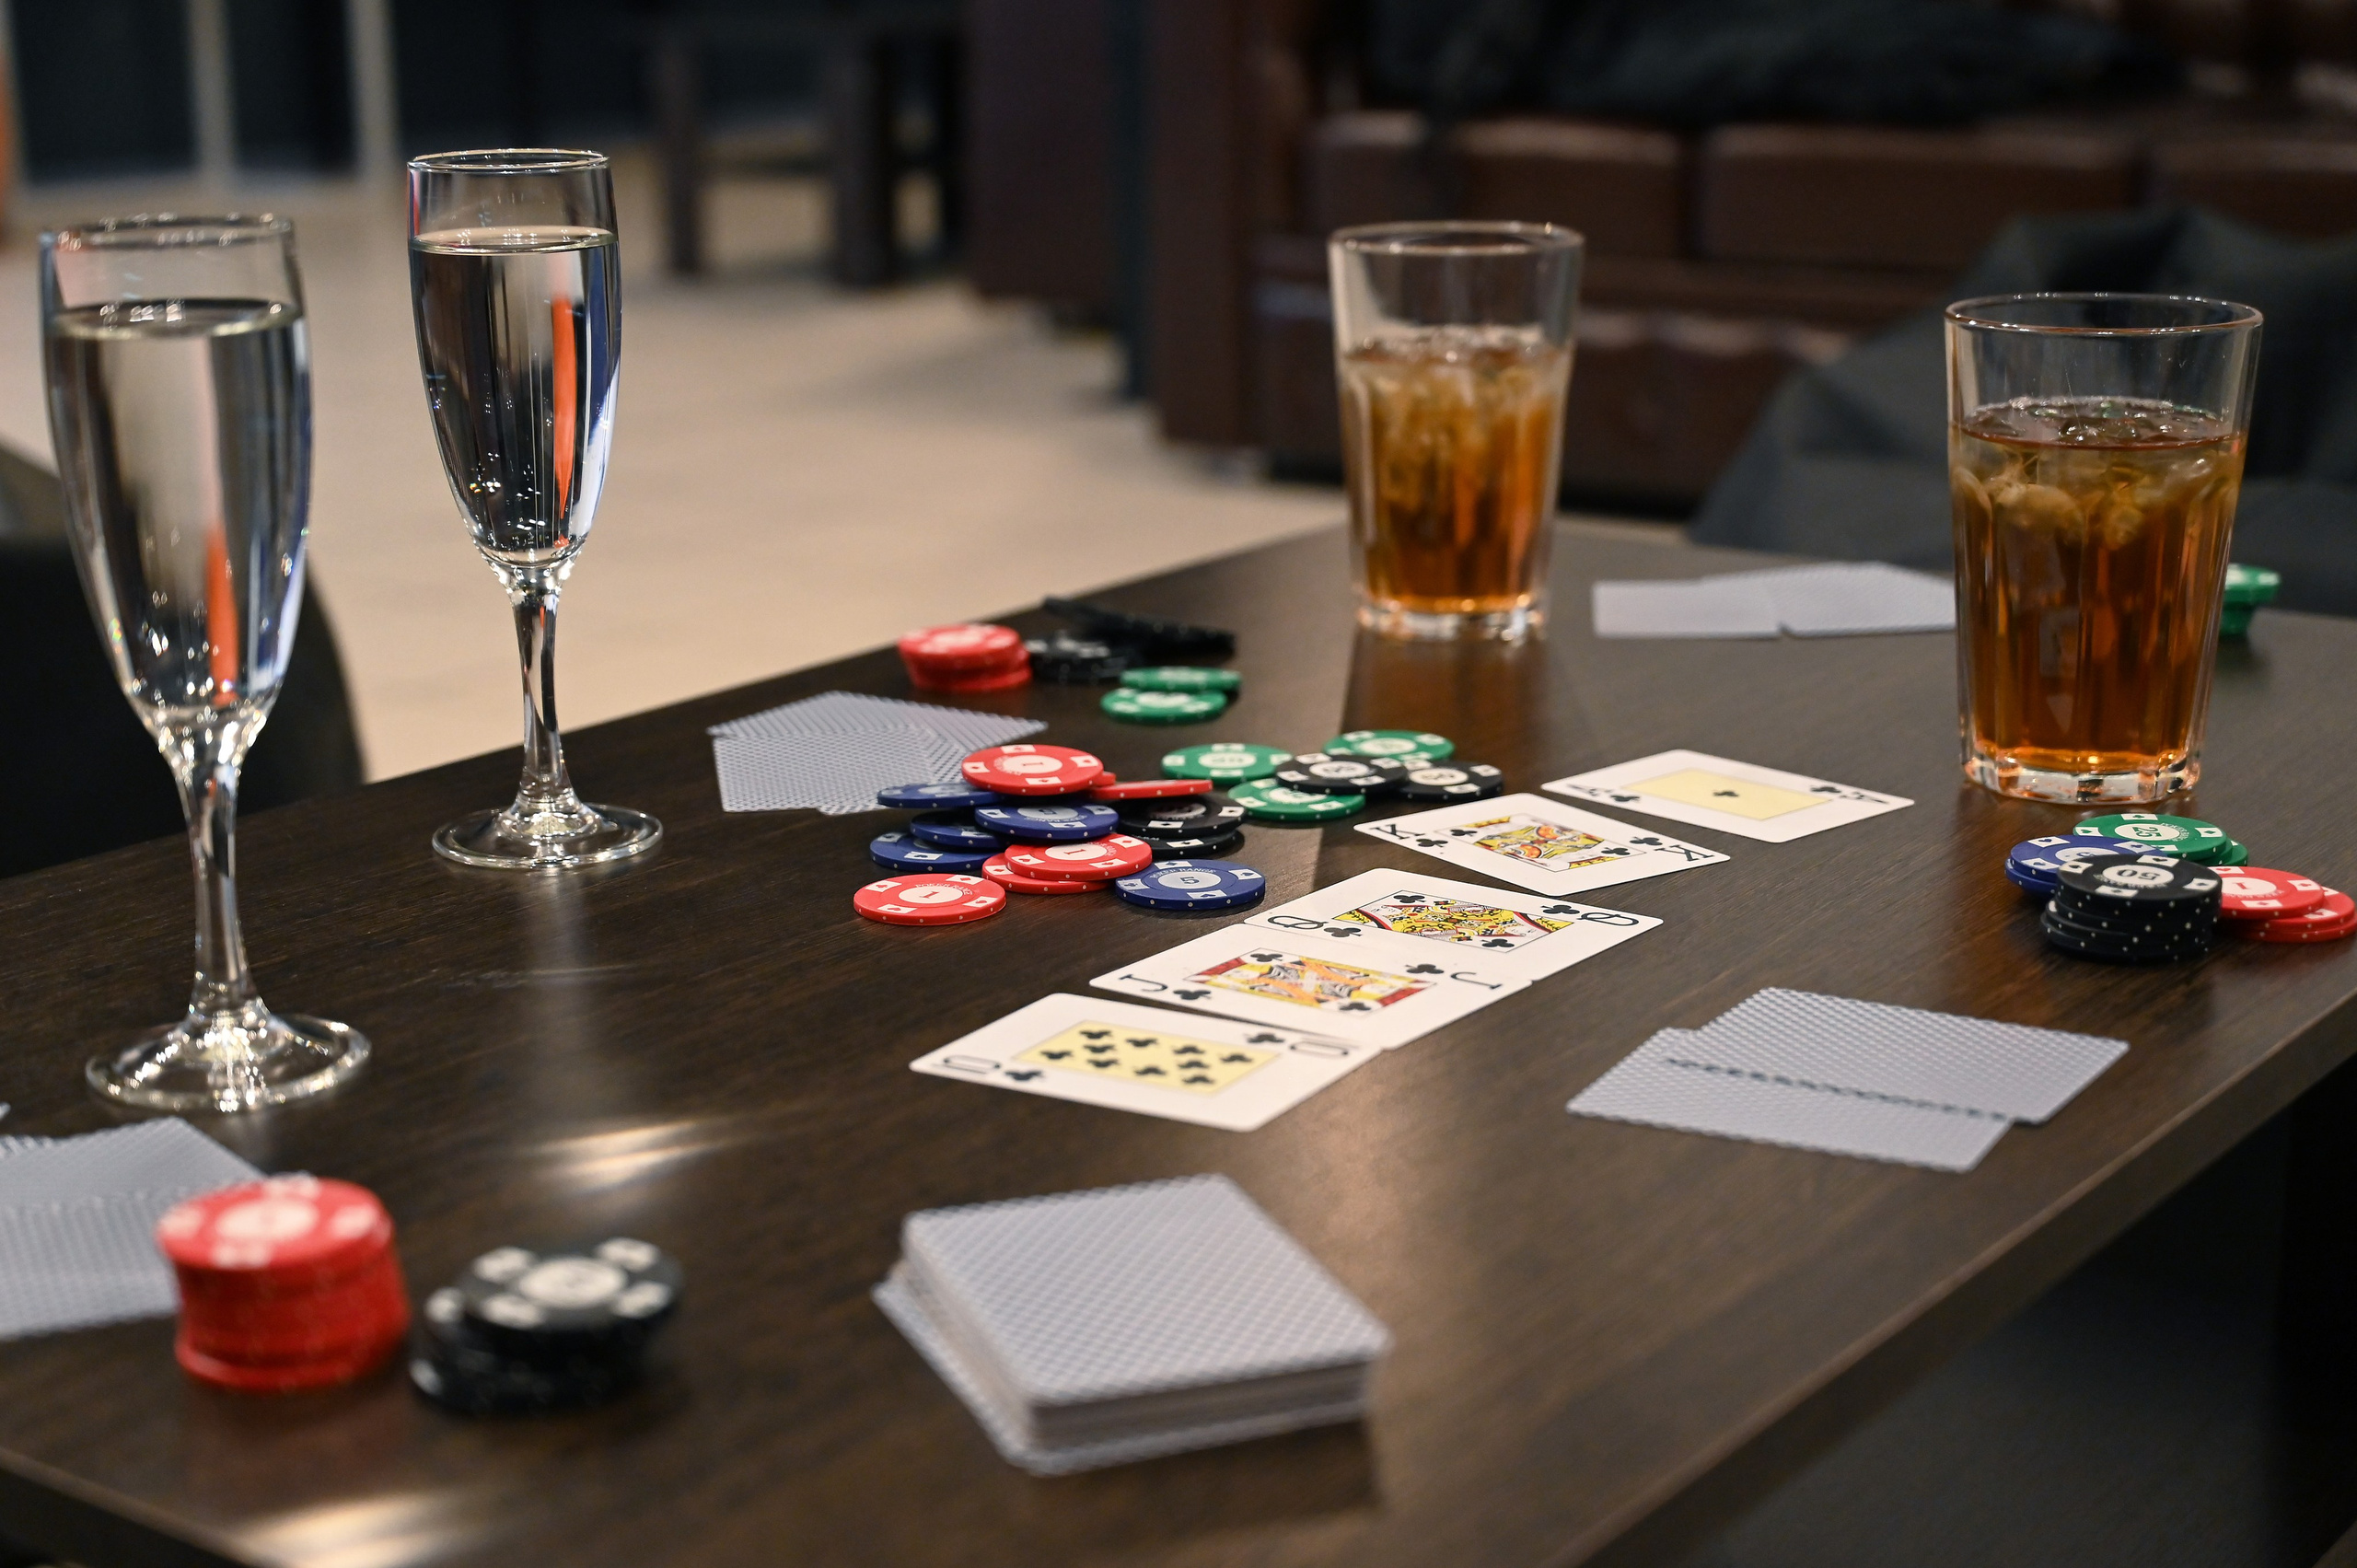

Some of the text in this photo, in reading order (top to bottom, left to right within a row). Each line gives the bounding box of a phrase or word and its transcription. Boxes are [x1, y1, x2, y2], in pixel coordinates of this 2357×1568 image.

[1369, 824, 1425, 840] K
[2131, 827, 2162, 837] 25
[1654, 844, 1714, 862] K
[2117, 869, 2161, 881] 50
[2232, 882, 2250, 890] 1
[1267, 915, 1329, 930] Q
[1576, 912, 1640, 926] Q
[1119, 974, 1168, 992] J
[1450, 971, 1503, 990] J
[1289, 1037, 1361, 1059] 10
[933, 1055, 1002, 1074] 10
